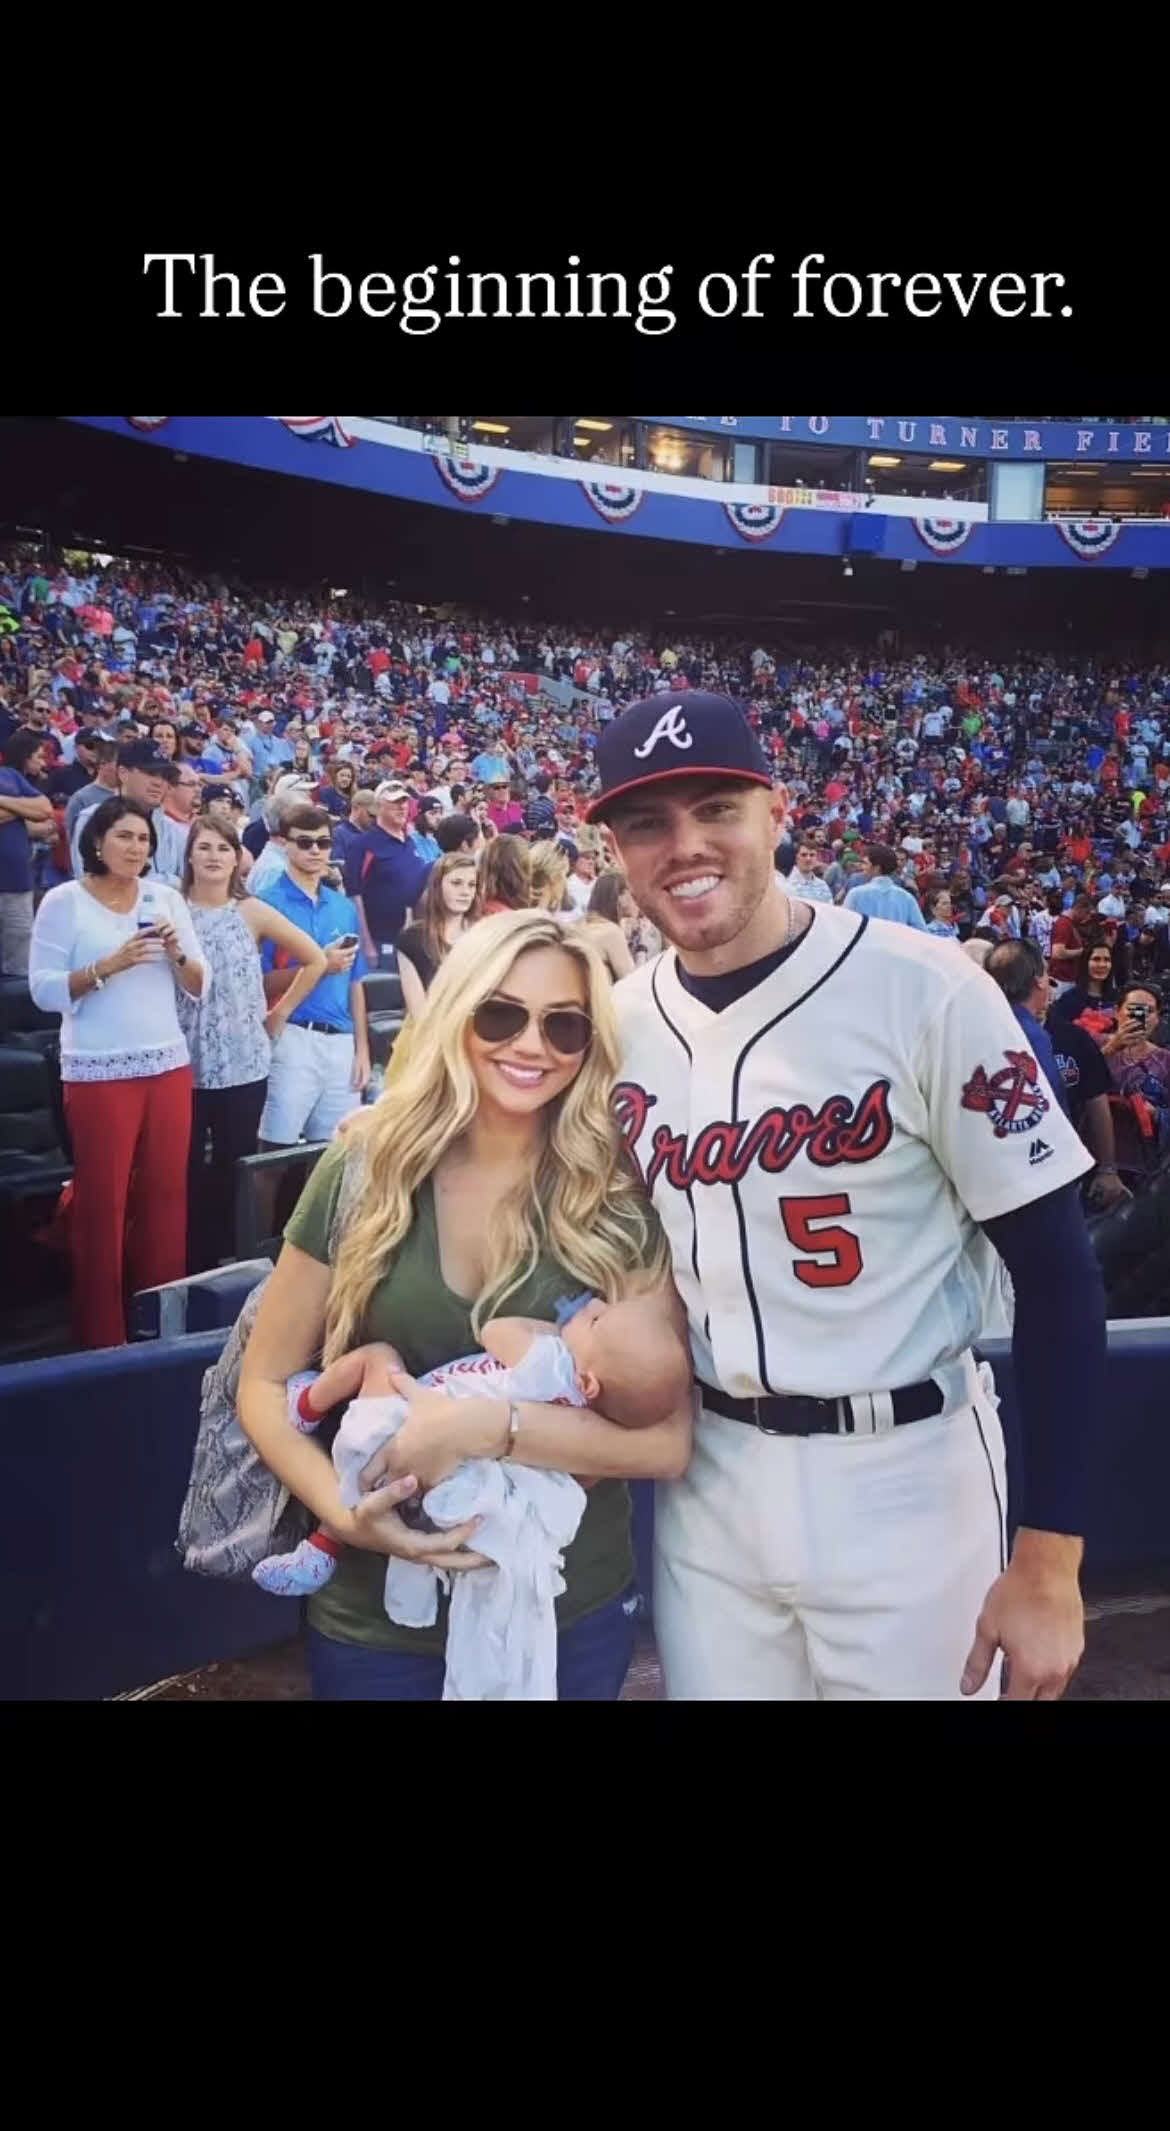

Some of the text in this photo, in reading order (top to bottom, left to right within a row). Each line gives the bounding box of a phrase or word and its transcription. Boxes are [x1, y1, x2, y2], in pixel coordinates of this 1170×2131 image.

[867, 417, 1042, 451] TURNER
[1076, 430, 1170, 453] FIE
[634, 705, 693, 759] A
[778, 1192, 863, 1288] 5
